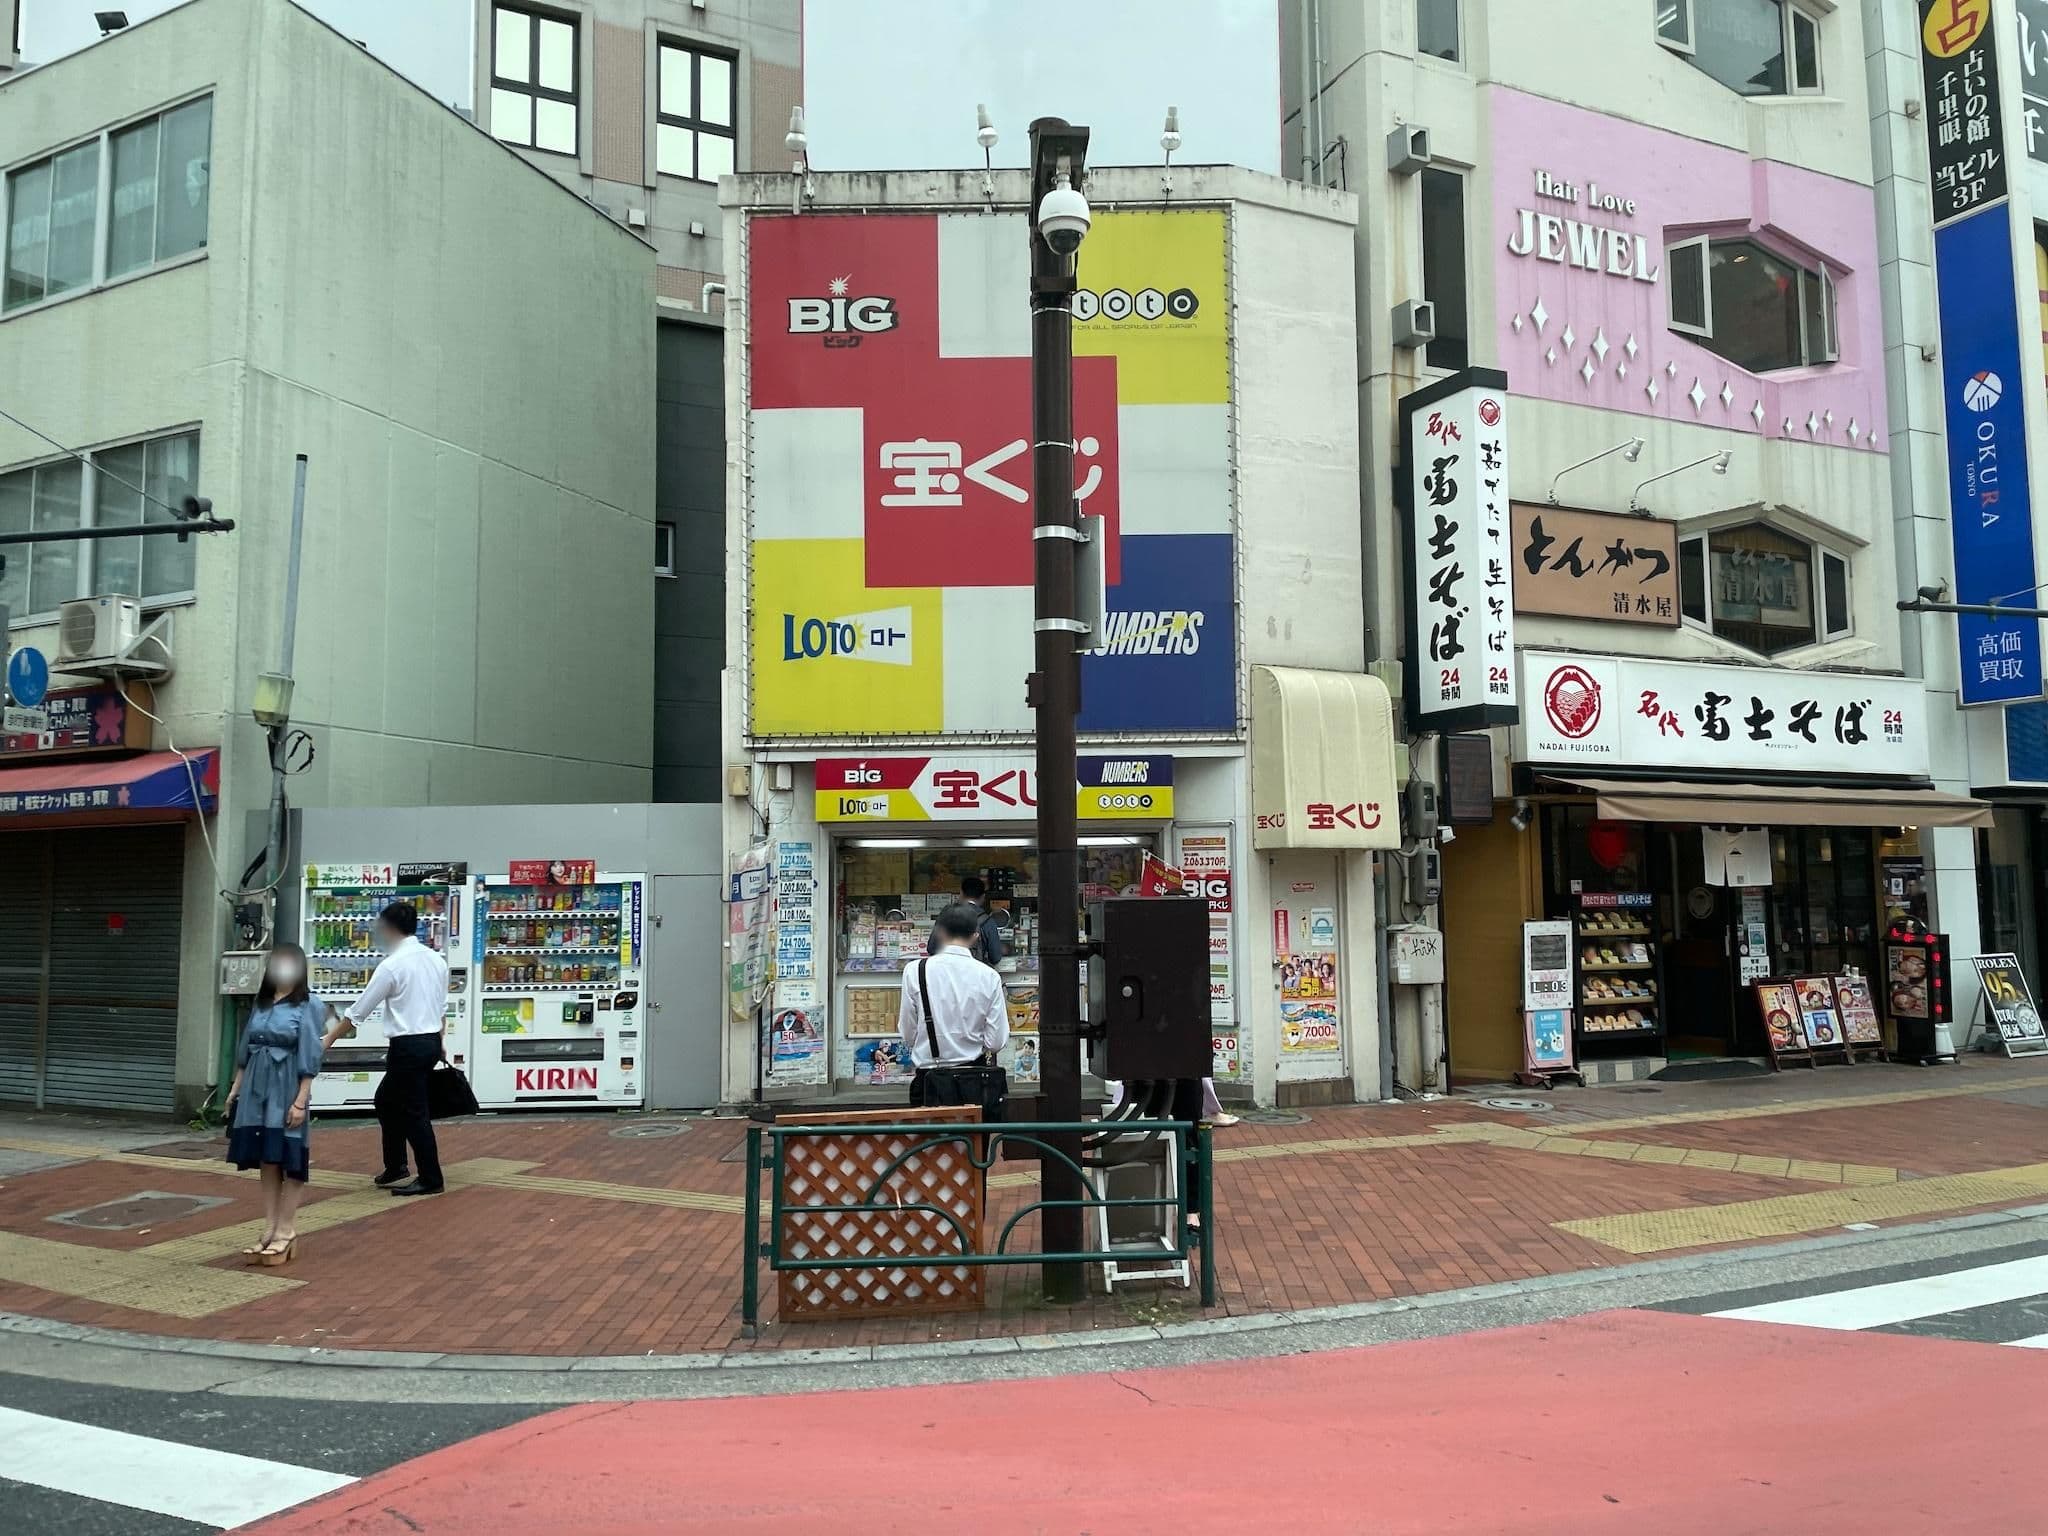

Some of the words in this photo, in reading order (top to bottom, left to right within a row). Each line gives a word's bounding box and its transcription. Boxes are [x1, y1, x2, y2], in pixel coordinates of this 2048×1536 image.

[1936, 71, 1962, 147] 千里眼
[1963, 50, 1991, 145] 占いの館
[1936, 149, 2001, 191] 当ビル
[1535, 169, 1580, 204] Hair
[1588, 183, 1636, 216] Love
[1952, 178, 1987, 209] 3F
[1507, 208, 1660, 283] JEWEL
[787, 295, 898, 333] BIG
[1072, 287, 1199, 321] toto
[1425, 411, 1462, 446] 名代
[1966, 461, 1976, 497] TOKYO
[1977, 421, 2000, 528] OKURA
[1423, 454, 1469, 662] 富士そば
[1523, 515, 1671, 585] とんかつ
[1613, 592, 1673, 618] 清水屋
[783, 613, 856, 661] LOTO
[1084, 611, 1205, 656] UMBERS
[1977, 630, 2022, 657] 高価
[1441, 668, 1460, 686] 24
[1489, 667, 1508, 682] 24
[1979, 658, 2025, 684] 買取
[1441, 686, 1461, 700] 時間
[1489, 682, 1509, 695] 時間
[1637, 690, 1685, 738] 名代
[1695, 691, 1873, 745] 富士そば
[1883, 710, 1903, 723] 24
[1883, 723, 1904, 735] 時間
[1539, 742, 1567, 751] NADAI
[1570, 743, 1611, 752] FUJISOBA
[844, 765, 883, 784] BIG
[1100, 760, 1150, 784] NUMBERS
[839, 797, 867, 816] LOTO
[1098, 794, 1153, 808] toto
[1257, 812, 1285, 829] 宝くじ
[1307, 803, 1381, 830] 宝くじ
[321, 873, 361, 885] 茶カテキン
[362, 867, 392, 885] No.1
[1182, 879, 1228, 898] BIG
[1976, 957, 2017, 969] ROLEX
[516, 1068, 598, 1090] KIRIN
